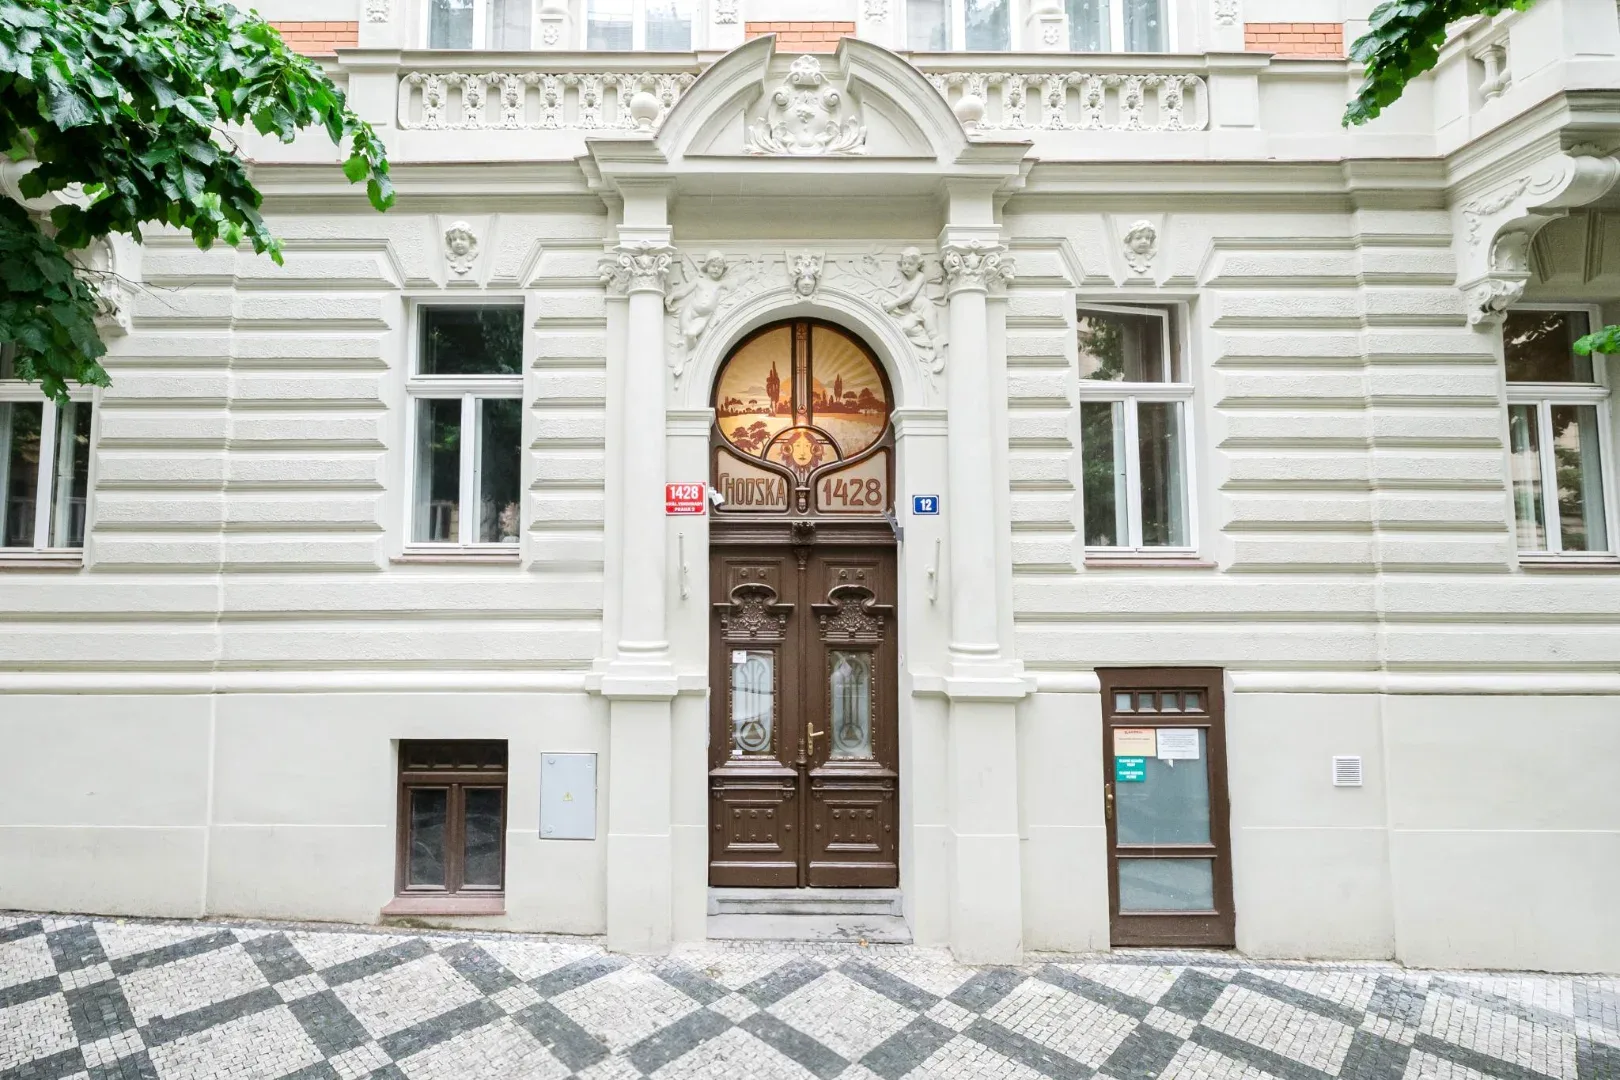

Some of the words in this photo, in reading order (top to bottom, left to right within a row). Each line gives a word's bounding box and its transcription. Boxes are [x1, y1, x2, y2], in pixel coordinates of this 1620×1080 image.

[670, 486, 699, 500] 1428
[823, 478, 882, 506] 1428
[920, 498, 932, 511] 12
